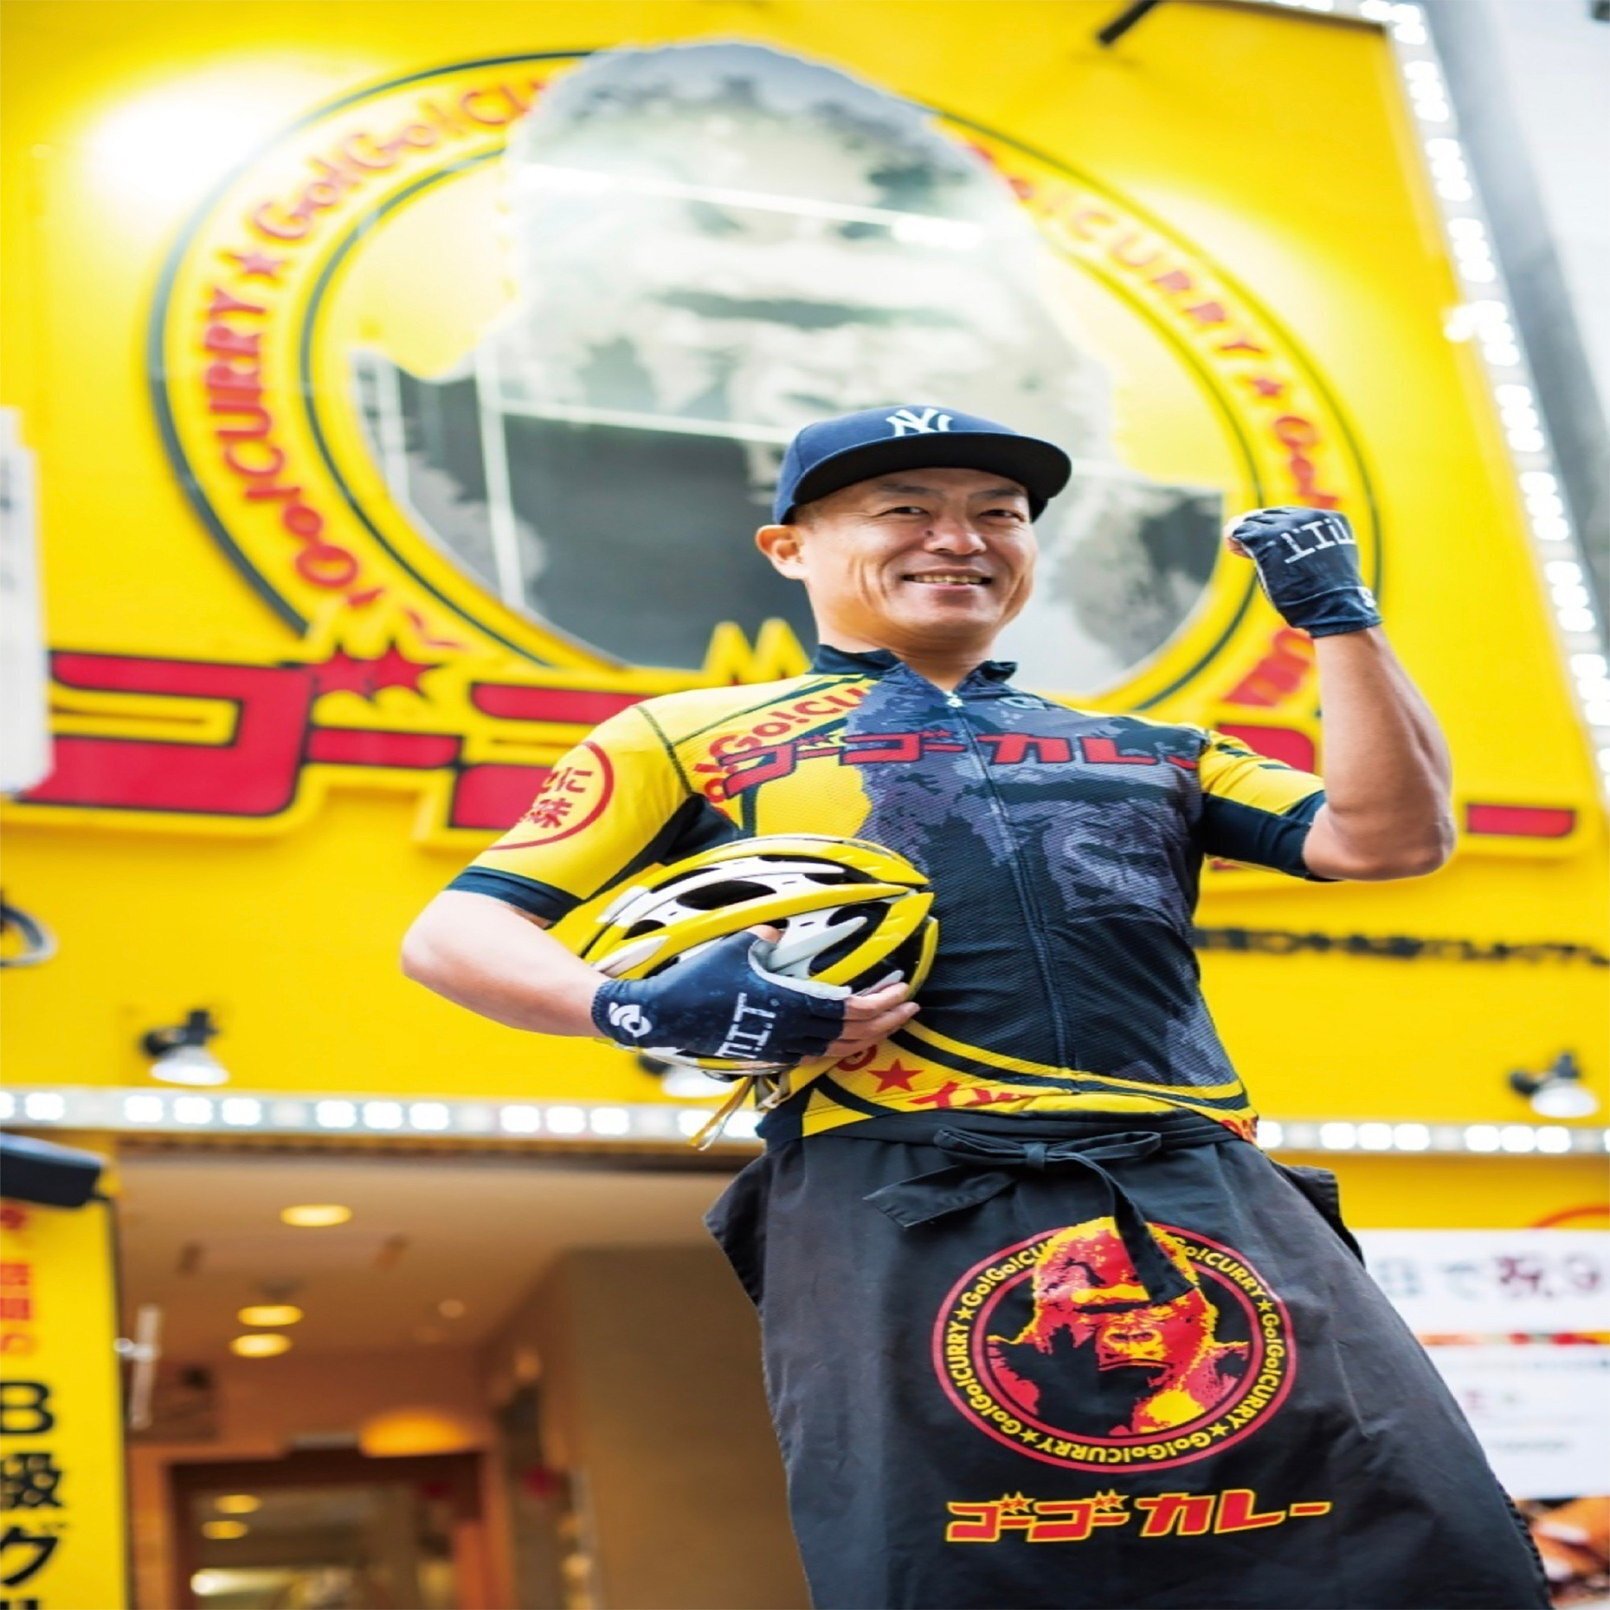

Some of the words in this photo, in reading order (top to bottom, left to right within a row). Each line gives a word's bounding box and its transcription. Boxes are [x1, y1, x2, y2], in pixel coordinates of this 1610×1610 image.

[886, 408, 953, 437] NY
[946, 1488, 1332, 1543] ゴーゴーカレー
